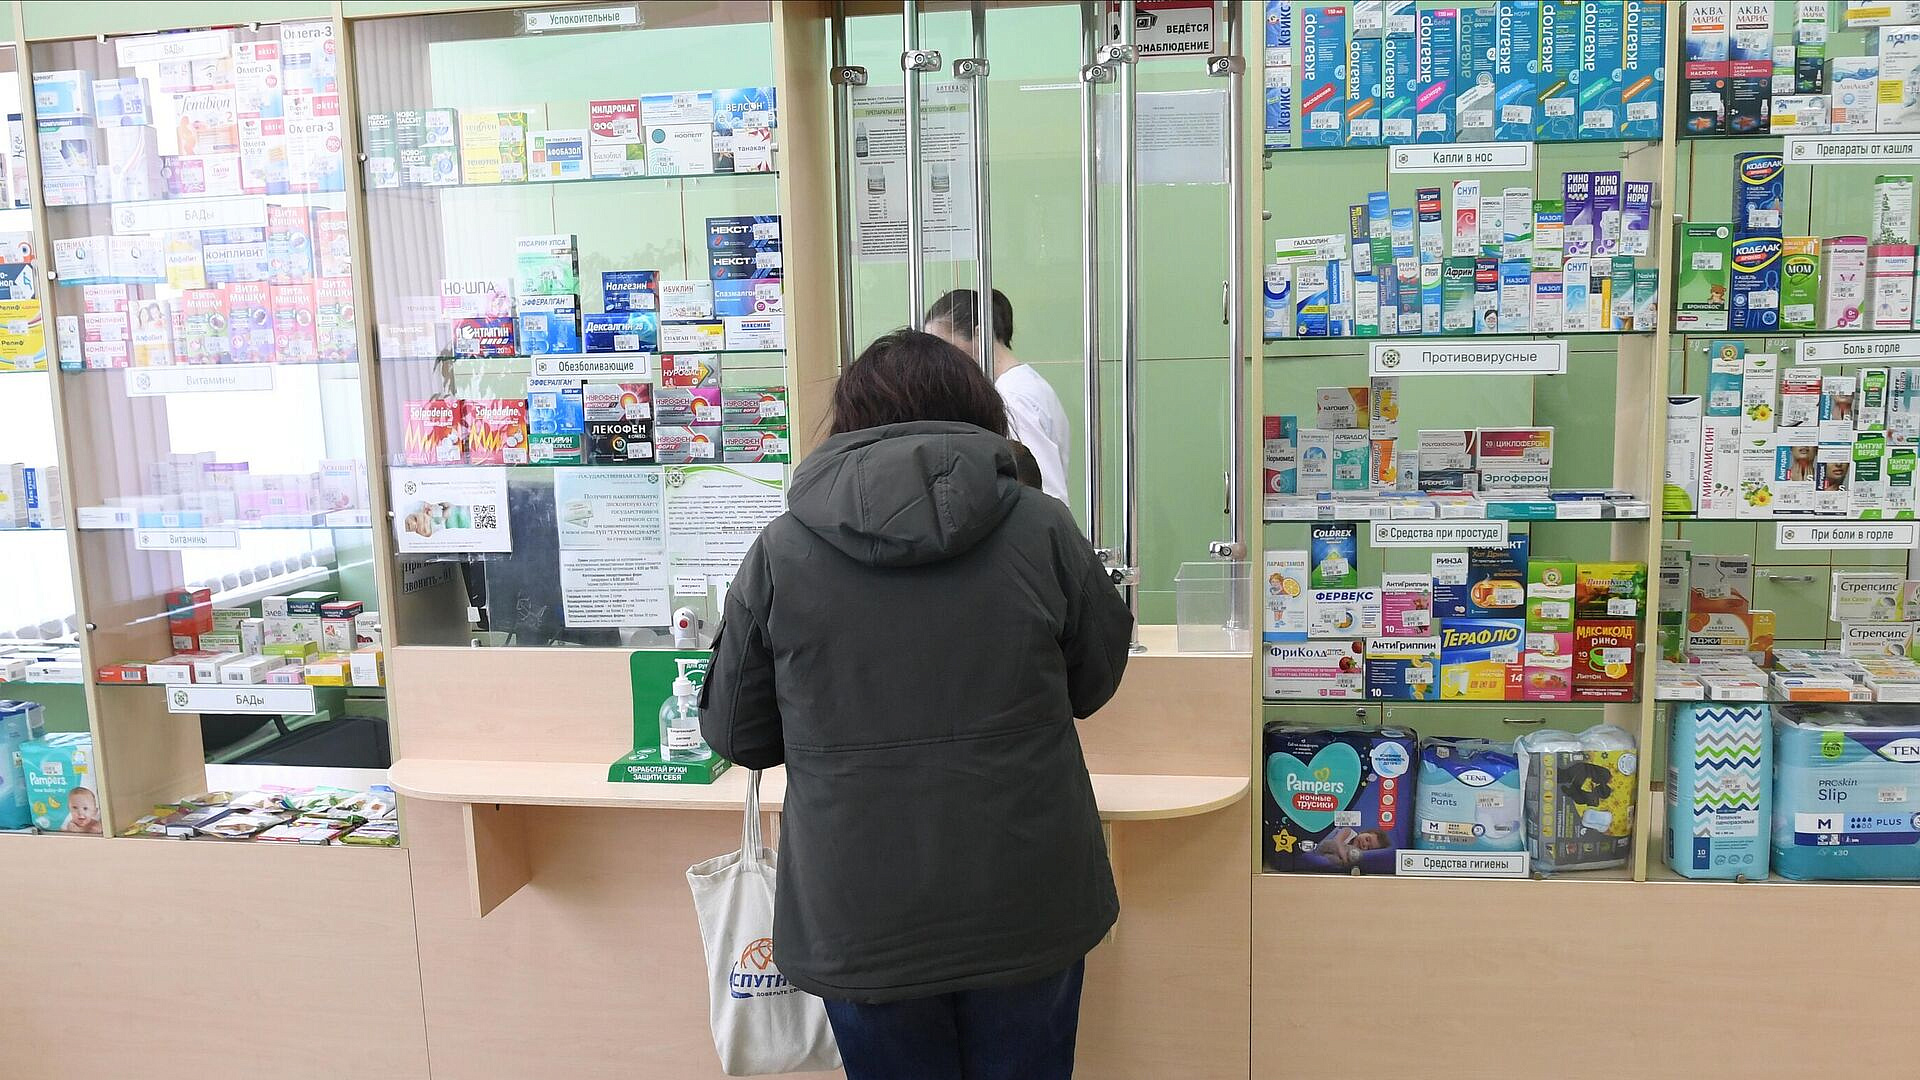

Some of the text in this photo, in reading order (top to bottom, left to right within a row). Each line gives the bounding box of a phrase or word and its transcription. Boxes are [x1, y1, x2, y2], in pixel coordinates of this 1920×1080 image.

[1693, 7, 1723, 16] АКВА
[1737, 6, 1768, 14] АКВА
[549, 13, 620, 25] Успокоительные
[1693, 15, 1724, 23] МАРИС
[1737, 15, 1767, 23] МАРИС
[1167, 23, 1209, 34] ВЕДЁТСЯ
[1501, 7, 1512, 74] аквалор
[1543, 5, 1554, 73] аквалор
[1585, 3, 1596, 71] аквалор
[1627, 2, 1639, 70] аквалор
[1137, 41, 1209, 52] ОНАБЛЮДЕНИЕ
[1304, 14, 1317, 81] аквалор
[1421, 16, 1433, 83] аквалор
[1461, 15, 1472, 78] аквалор
[1351, 42, 1361, 100] аквалор
[1385, 40, 1396, 98] аквалор
[591, 105, 636, 114] МИЛДРОНАТ
[1279, 87, 1291, 128] Квикс
[547, 148, 582, 157] АФОБАЗОЛ
[1816, 144, 1913, 156] Препараты от кашля
[1434, 152, 1463, 163] Капли
[1476, 153, 1492, 162] нос
[1746, 159, 1782, 170] КОДЕЛАК
[1568, 174, 1588, 183] РИНО
[1595, 176, 1617, 185] РИНО
[1458, 187, 1478, 195] СНУП
[1568, 183, 1588, 192] НОРМ
[1595, 185, 1617, 195] НОРМ
[1628, 184, 1649, 193] РИНО
[1627, 193, 1648, 203] НОРМ
[184, 208, 215, 221] БАДы
[1294, 238, 1329, 246] ГАЛАЗОЛИН
[206, 248, 264, 259] КОМПЛИВИТ
[1736, 244, 1781, 254] КОДЕЛАК
[1568, 262, 1588, 271] СНУП
[1788, 263, 1812, 273] МОМ
[1445, 267, 1473, 280] Африн
[444, 282, 496, 294] НО-ШПА
[606, 282, 647, 291] Налгезин
[663, 285, 694, 293] ИБУКЛИН
[1844, 344, 1864, 354] Боль
[1875, 344, 1900, 353] горле
[1422, 352, 1538, 367] Противовирусные
[558, 360, 635, 373] Обезболивающие
[186, 375, 236, 386] Витамины
[592, 425, 645, 434] ЛЕКОФЕН
[1855, 443, 1884, 451] ТАНТУМ
[1858, 449, 1879, 457] ВЕРДЕ
[1703, 427, 1714, 497] МИРАМИСТИН
[1484, 474, 1548, 483] Эргоферон
[1313, 529, 1351, 537] COLDREX
[1391, 528, 1498, 539] Средства при простуде
[1811, 529, 1830, 540] При
[1833, 529, 1855, 539] боли
[1867, 530, 1893, 540] горле
[169, 534, 208, 544] Витамины
[1840, 582, 1898, 592] Стрепсилс
[1315, 592, 1373, 601] ФЕРВЕКС
[1577, 626, 1632, 639] МАКСИКОЛД
[1849, 628, 1907, 639] Стрепсилс
[1443, 628, 1517, 648] ТЕРАФЛЮ
[1592, 638, 1617, 646] рино
[1691, 637, 1720, 645] АДЖИ
[1371, 641, 1436, 651] АнтиГриппин
[1271, 648, 1327, 659] ФриКолд
[1510, 674, 1522, 682] 14
[1371, 689, 1381, 697] 10
[236, 695, 265, 705] БАДы
[1892, 746, 1920, 755] TEN
[30, 772, 66, 786] Pampers
[1464, 774, 1487, 782] TENA
[1818, 778, 1858, 786] PROskin
[1287, 773, 1344, 794] Pampers
[1818, 789, 1848, 803] Slip
[1297, 801, 1333, 809] трусики
[1430, 797, 1457, 807] Pants
[1818, 819, 1831, 829] M
[1281, 835, 1287, 845] 5
[1423, 858, 1509, 869] Средства гигиены
[734, 974, 791, 987] СПУТН
